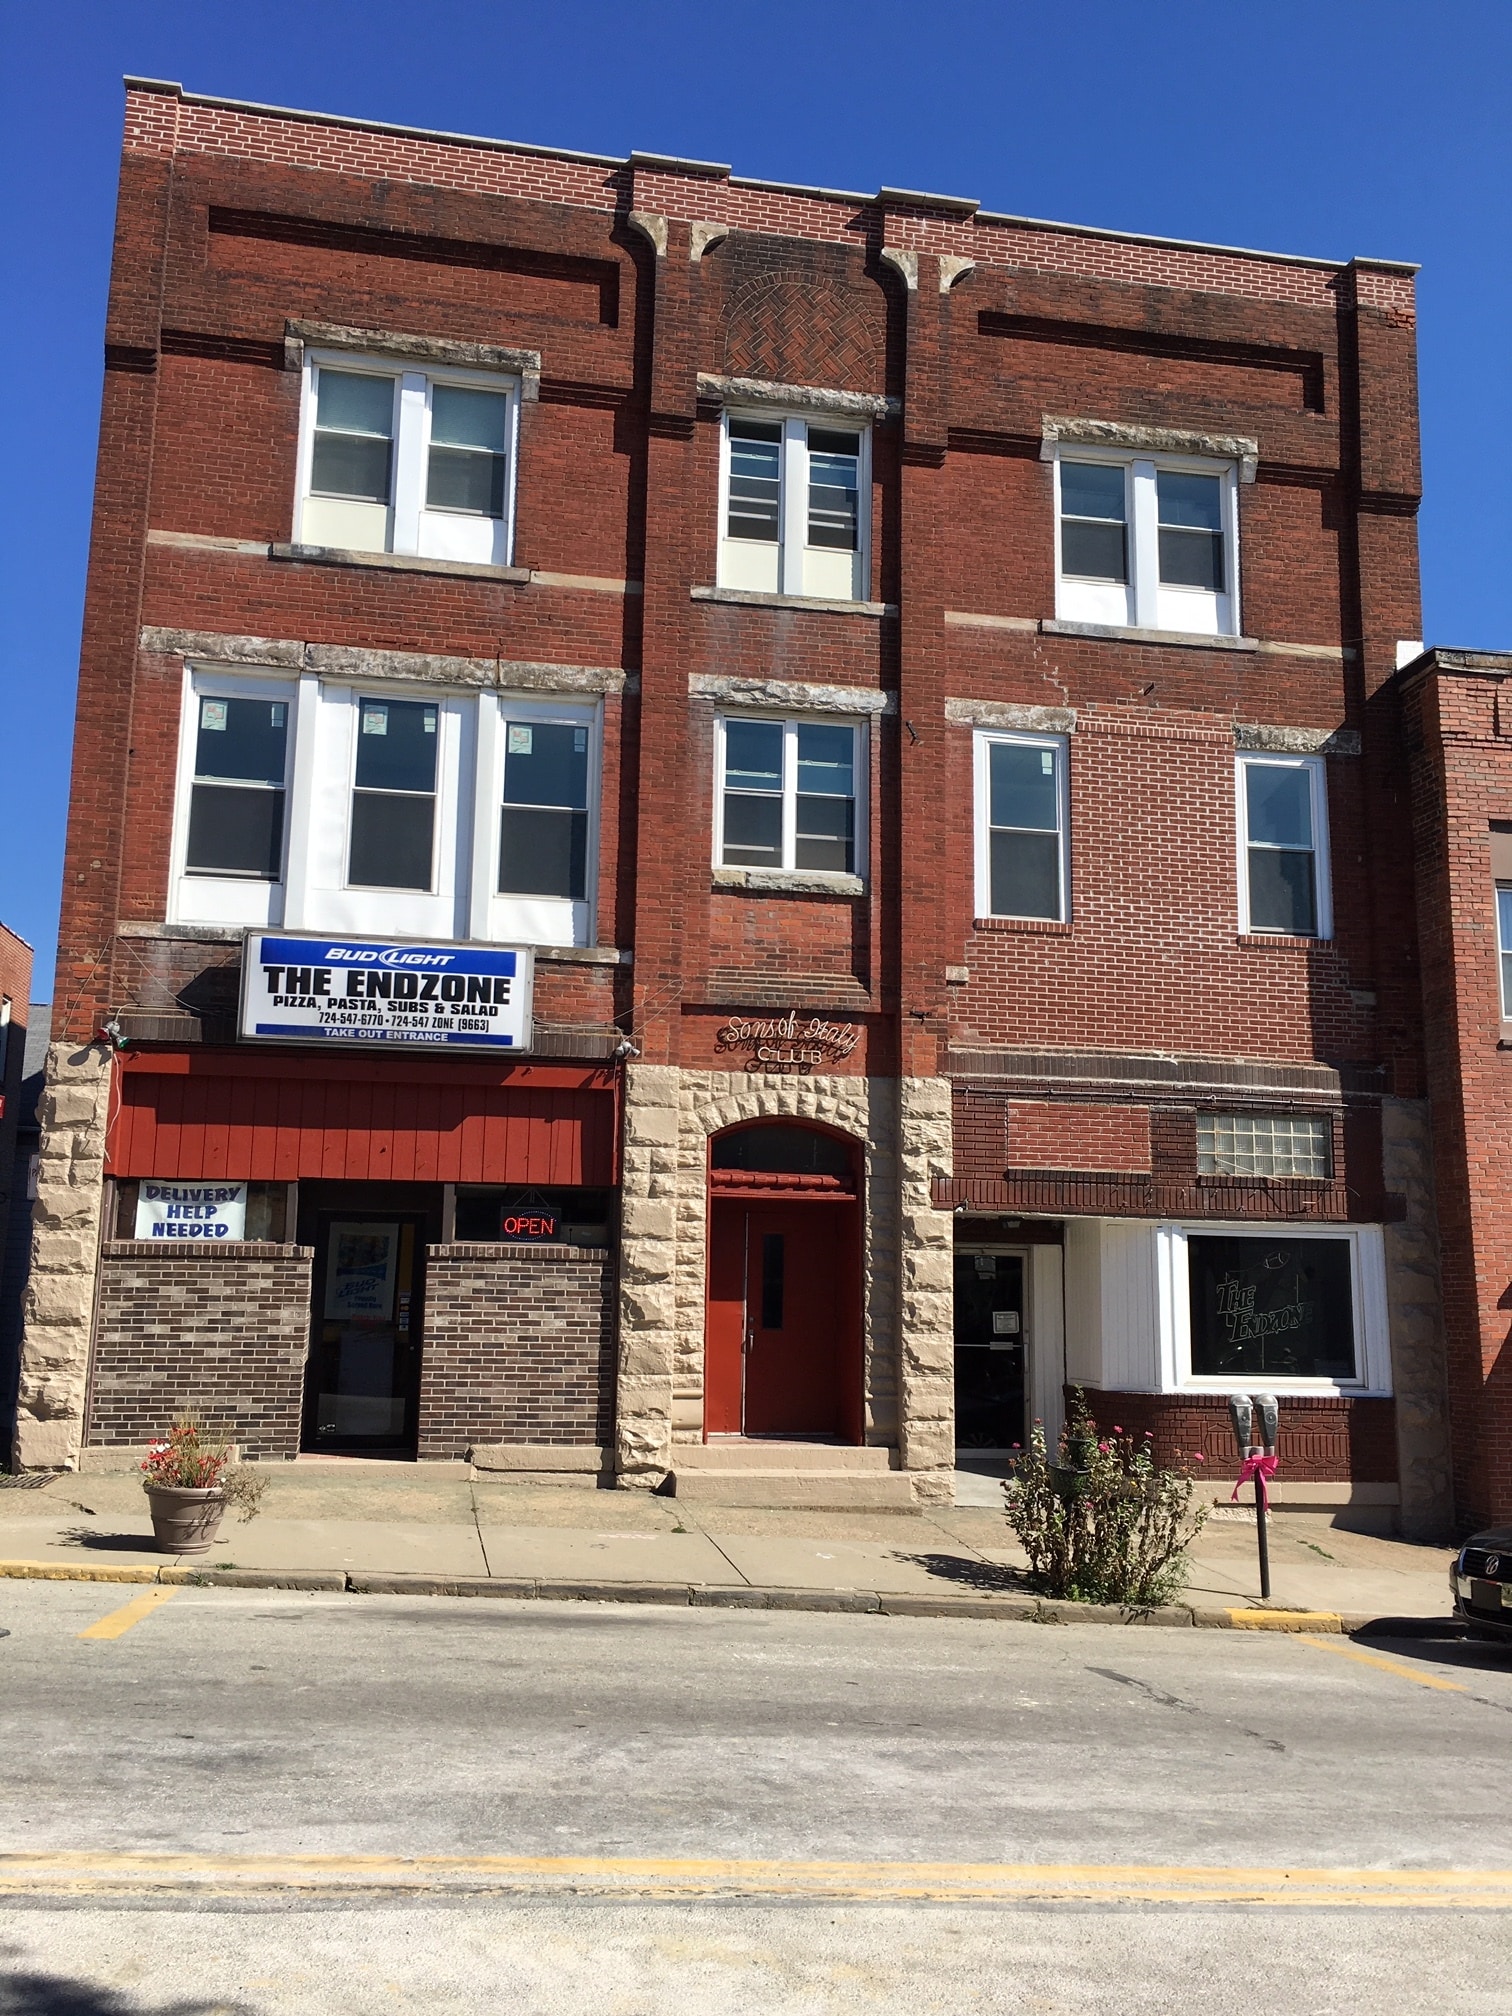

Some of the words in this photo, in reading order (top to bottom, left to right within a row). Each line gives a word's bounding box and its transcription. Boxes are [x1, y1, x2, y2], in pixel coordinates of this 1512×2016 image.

[325, 948, 379, 961] BUD
[388, 952, 456, 966] LIGHT
[263, 966, 331, 996] THE
[346, 970, 511, 1005] ENDZONE
[273, 995, 321, 1011] PIZZA,
[327, 998, 381, 1013] PASTA,
[387, 1001, 429, 1013] SUBS
[434, 1002, 445, 1014] &
[450, 1003, 499, 1016] SALAD
[319, 1012, 384, 1026] 724-547-6770
[391, 1015, 429, 1028] 724-547
[432, 1017, 454, 1029] ZONE
[726, 1016, 775, 1042] Sons
[324, 1027, 355, 1038] TAKE
[358, 1029, 383, 1039] OUT
[386, 1030, 449, 1042] ENTRANCE
[757, 1047, 822, 1065] CLUB
[146, 1185, 241, 1202] DELIVERY
[166, 1204, 218, 1220] HELP
[152, 1222, 229, 1238] NEEDED
[504, 1217, 554, 1235] OPEN
